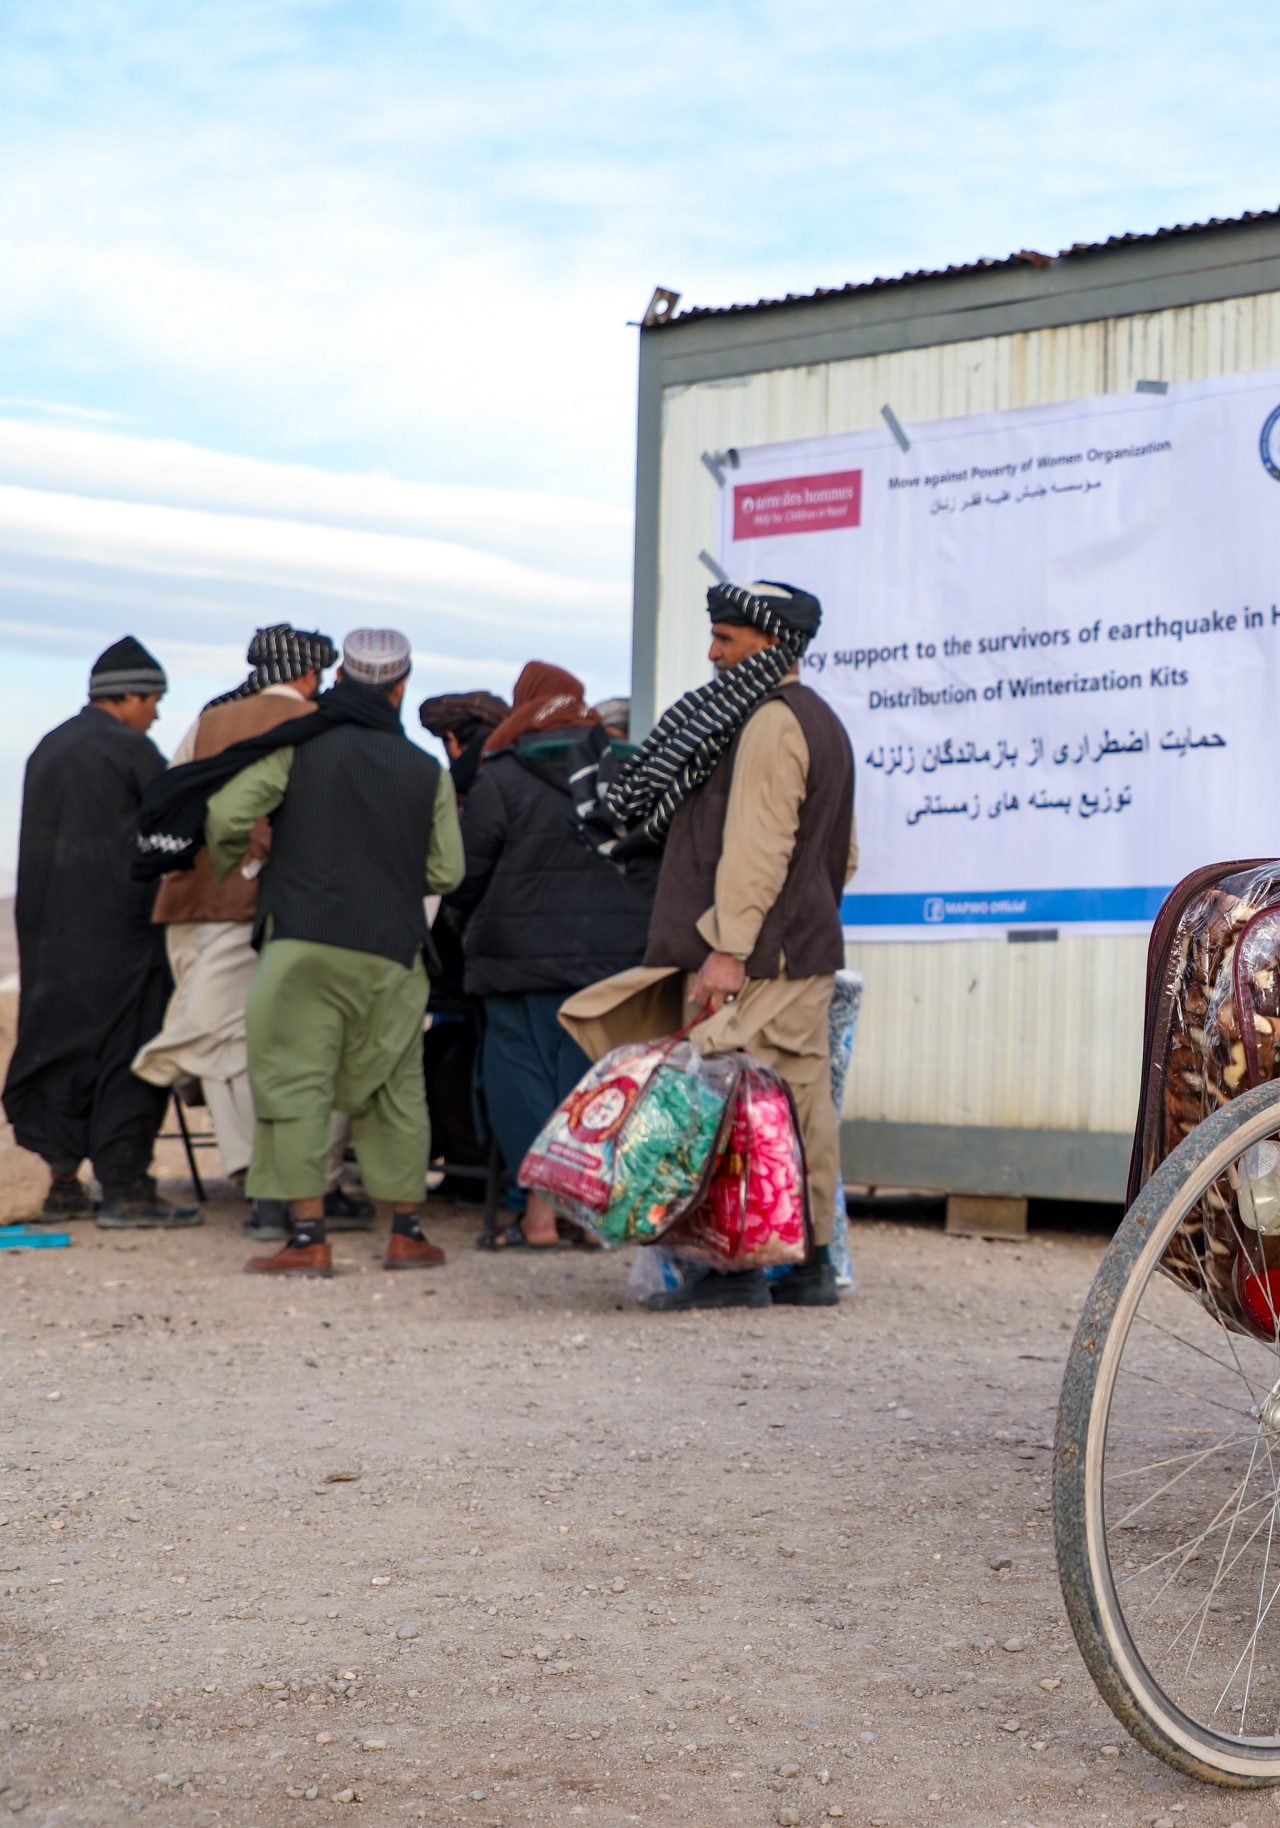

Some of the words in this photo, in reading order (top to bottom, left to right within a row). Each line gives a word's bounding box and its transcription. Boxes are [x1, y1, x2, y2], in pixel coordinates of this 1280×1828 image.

[888, 475, 921, 491] Move
[923, 468, 969, 489] against
[970, 461, 1018, 482] Poverty
[1020, 457, 1034, 473] of
[1037, 450, 1084, 469] Women
[1086, 439, 1172, 465] Organization
[833, 642, 910, 671] support
[915, 640, 937, 659] to
[943, 634, 974, 657] the
[977, 626, 1071, 653] survivors
[1077, 618, 1103, 644] of
[1107, 609, 1237, 643] earthquake
[1243, 604, 1264, 629] in
[868, 684, 977, 711] Distribution
[982, 677, 1004, 702] of
[1007, 667, 1143, 699] Winterization
[1149, 664, 1189, 688] Kits
[920, 737, 1020, 774] بازماندگان
[1026, 736, 1045, 768] از
[1052, 726, 1152, 766] اضطراری
[1159, 727, 1228, 759] حمایت
[864, 745, 917, 776] زلزله
[904, 793, 981, 826] زمستانی
[986, 790, 1020, 819] های
[1027, 789, 1073, 815] بسته
[1076, 783, 1134, 819] توزیع
